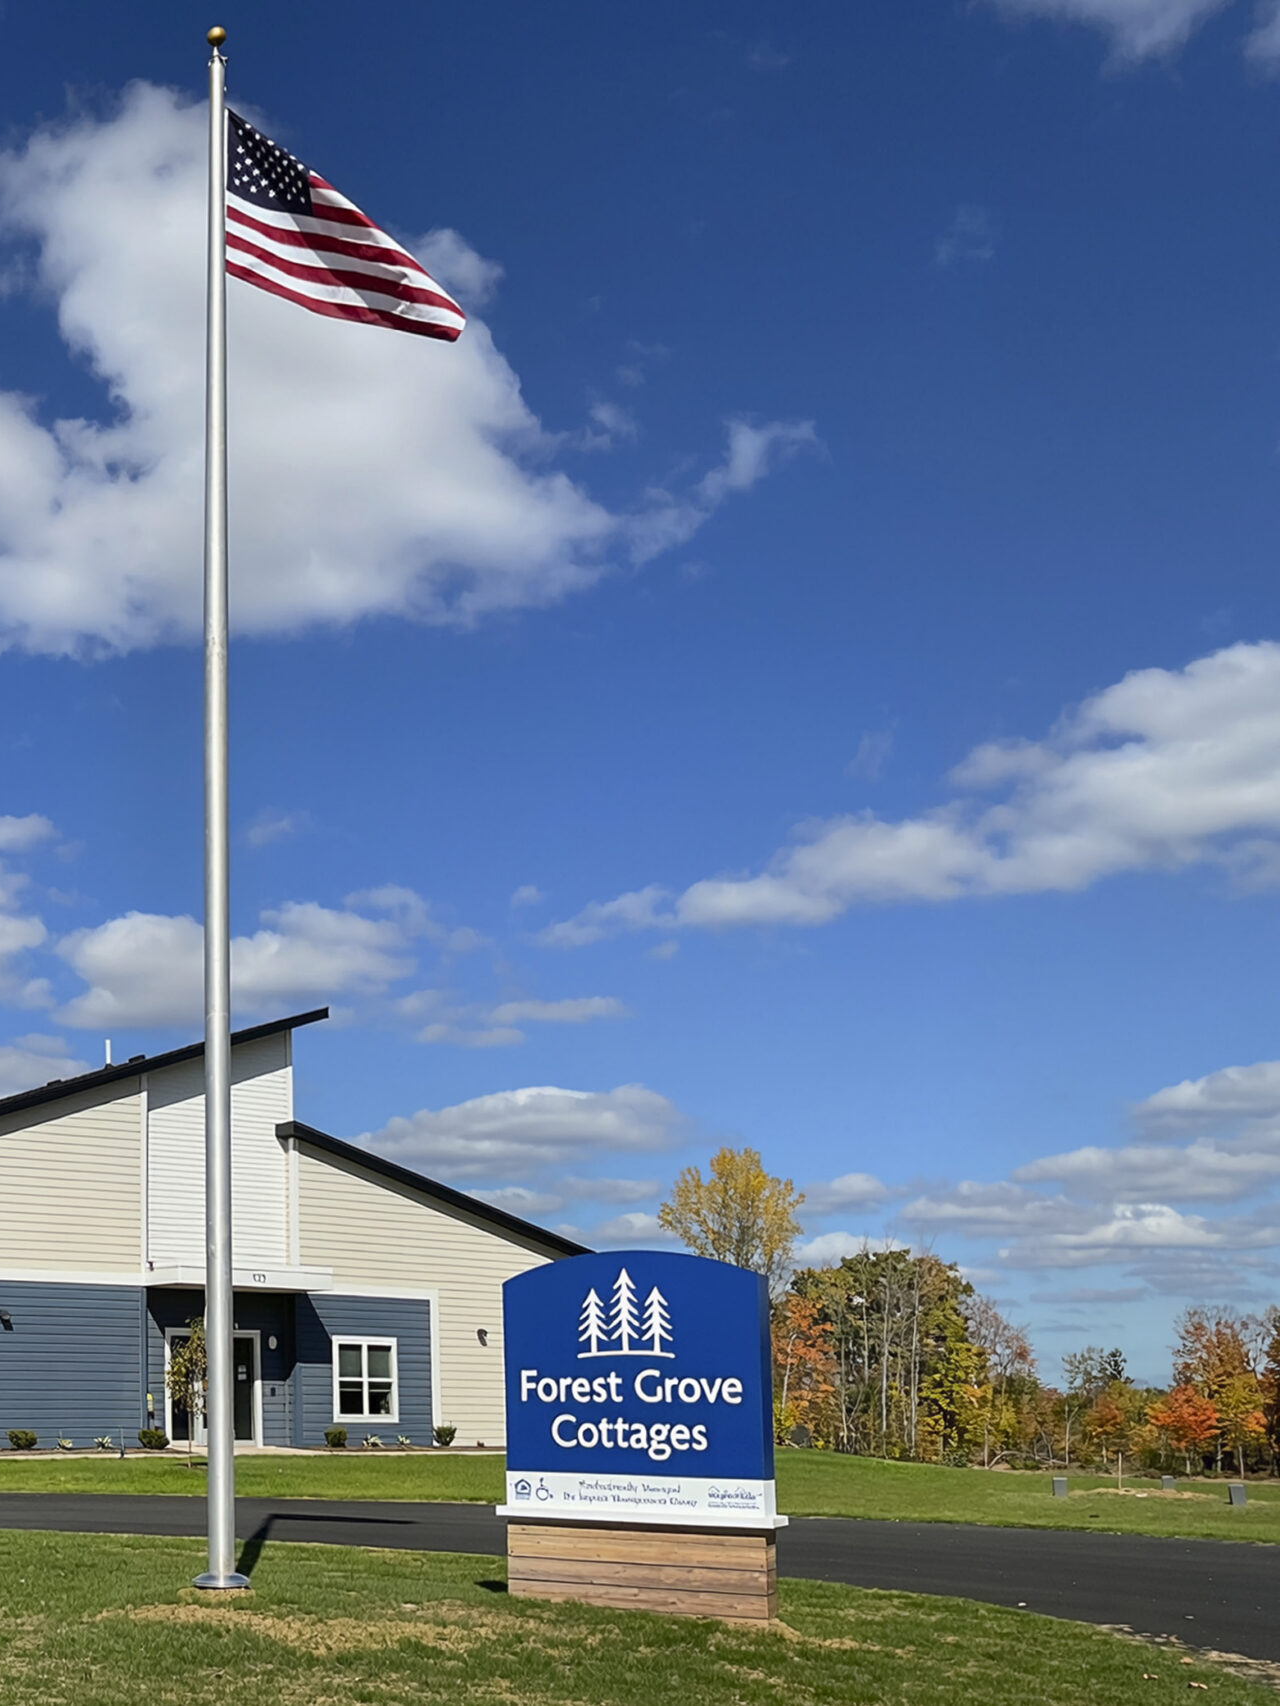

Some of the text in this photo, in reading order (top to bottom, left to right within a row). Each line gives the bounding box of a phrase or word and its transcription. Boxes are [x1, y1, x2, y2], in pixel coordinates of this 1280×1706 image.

[520, 1368, 743, 1404] Forest Grove
[551, 1414, 708, 1461] Cottages
